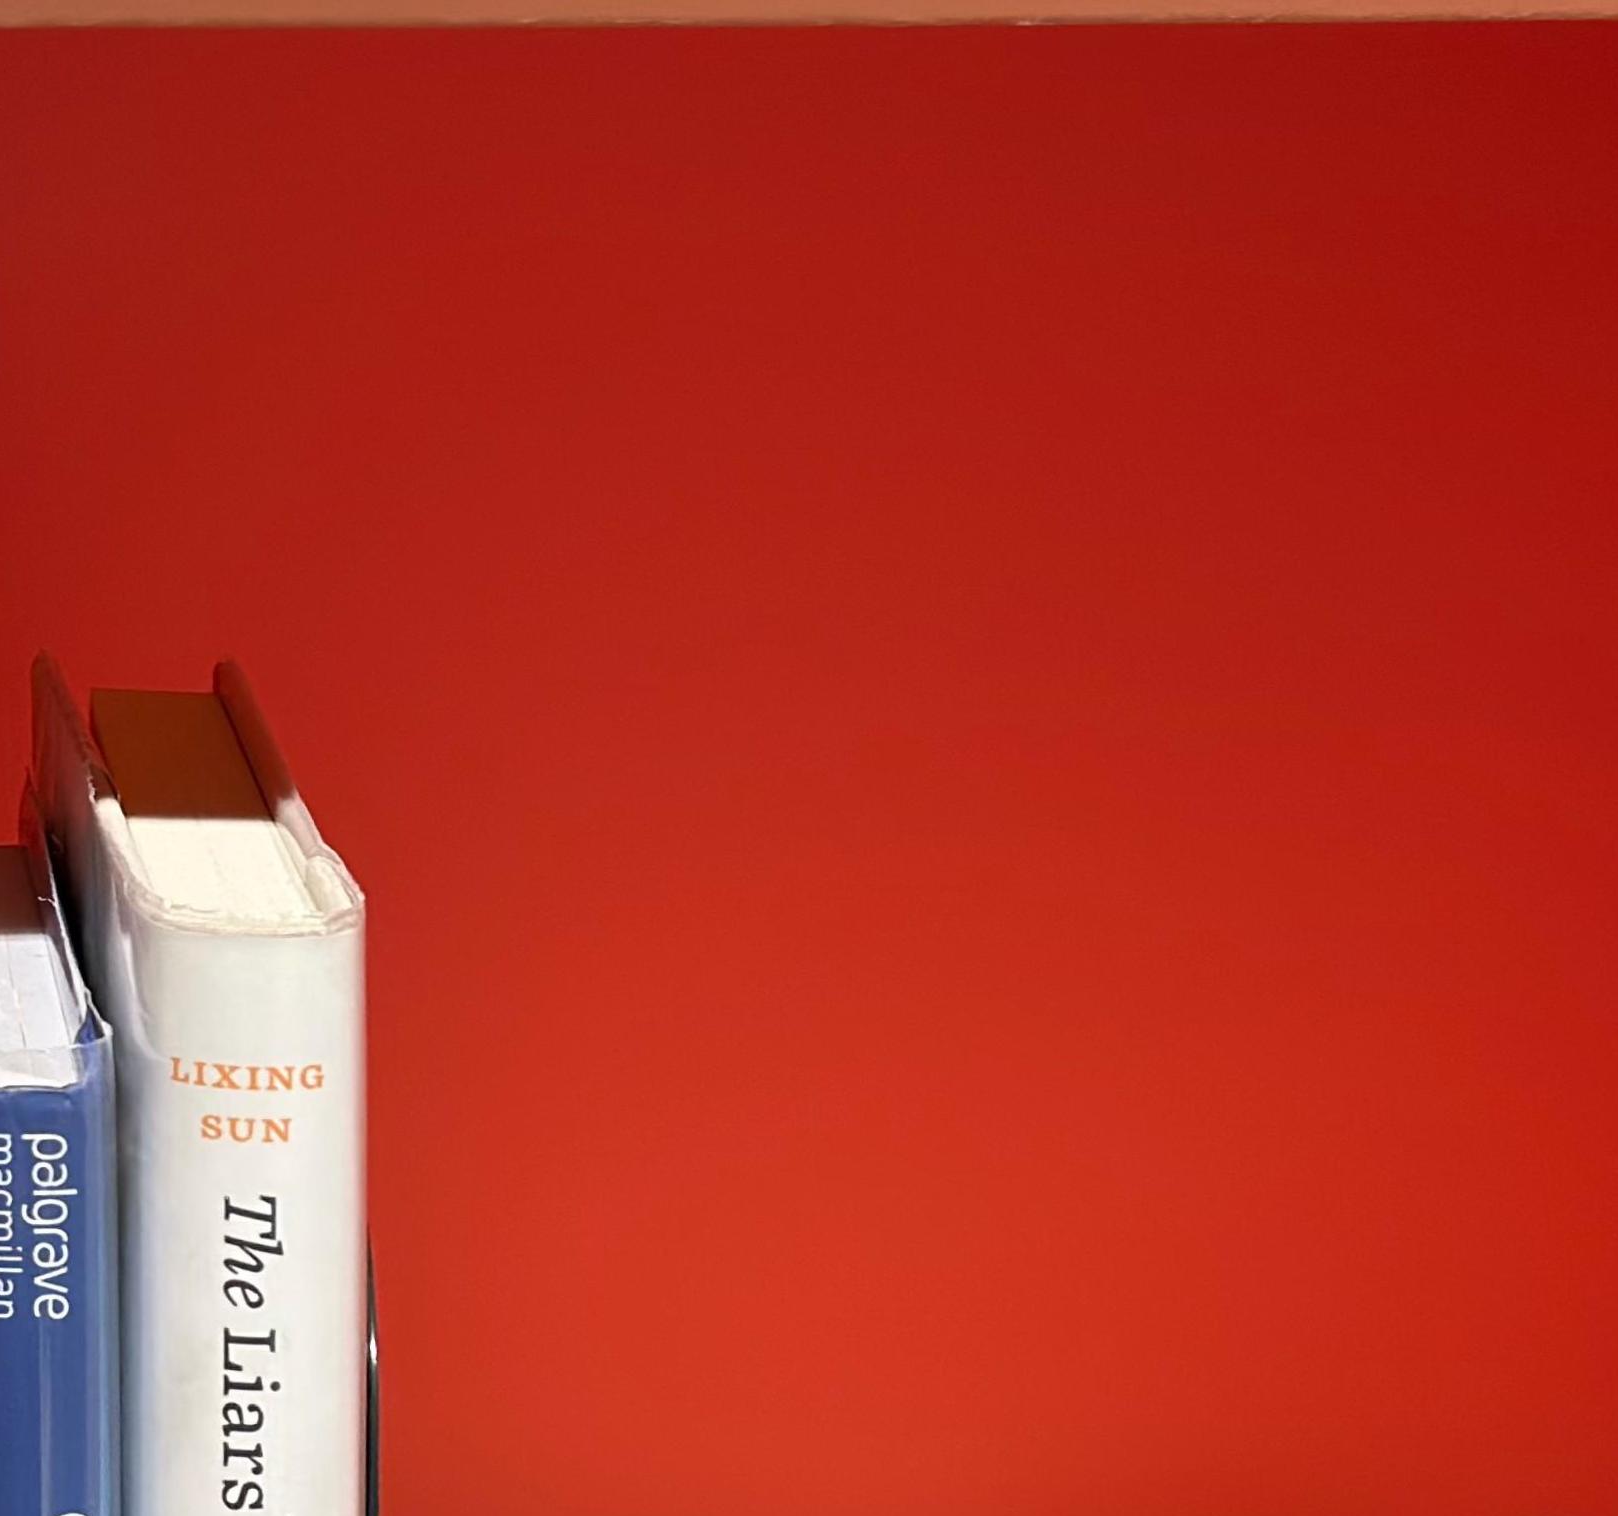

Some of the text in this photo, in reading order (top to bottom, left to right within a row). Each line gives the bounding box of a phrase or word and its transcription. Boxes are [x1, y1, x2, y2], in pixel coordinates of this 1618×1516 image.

[169, 1056, 324, 1091] LIXING
[200, 1115, 292, 1144] SUN
[21, 1132, 77, 1321] palgrave
[223, 1194, 284, 1310] The
[221, 1328, 281, 1511] Liars
